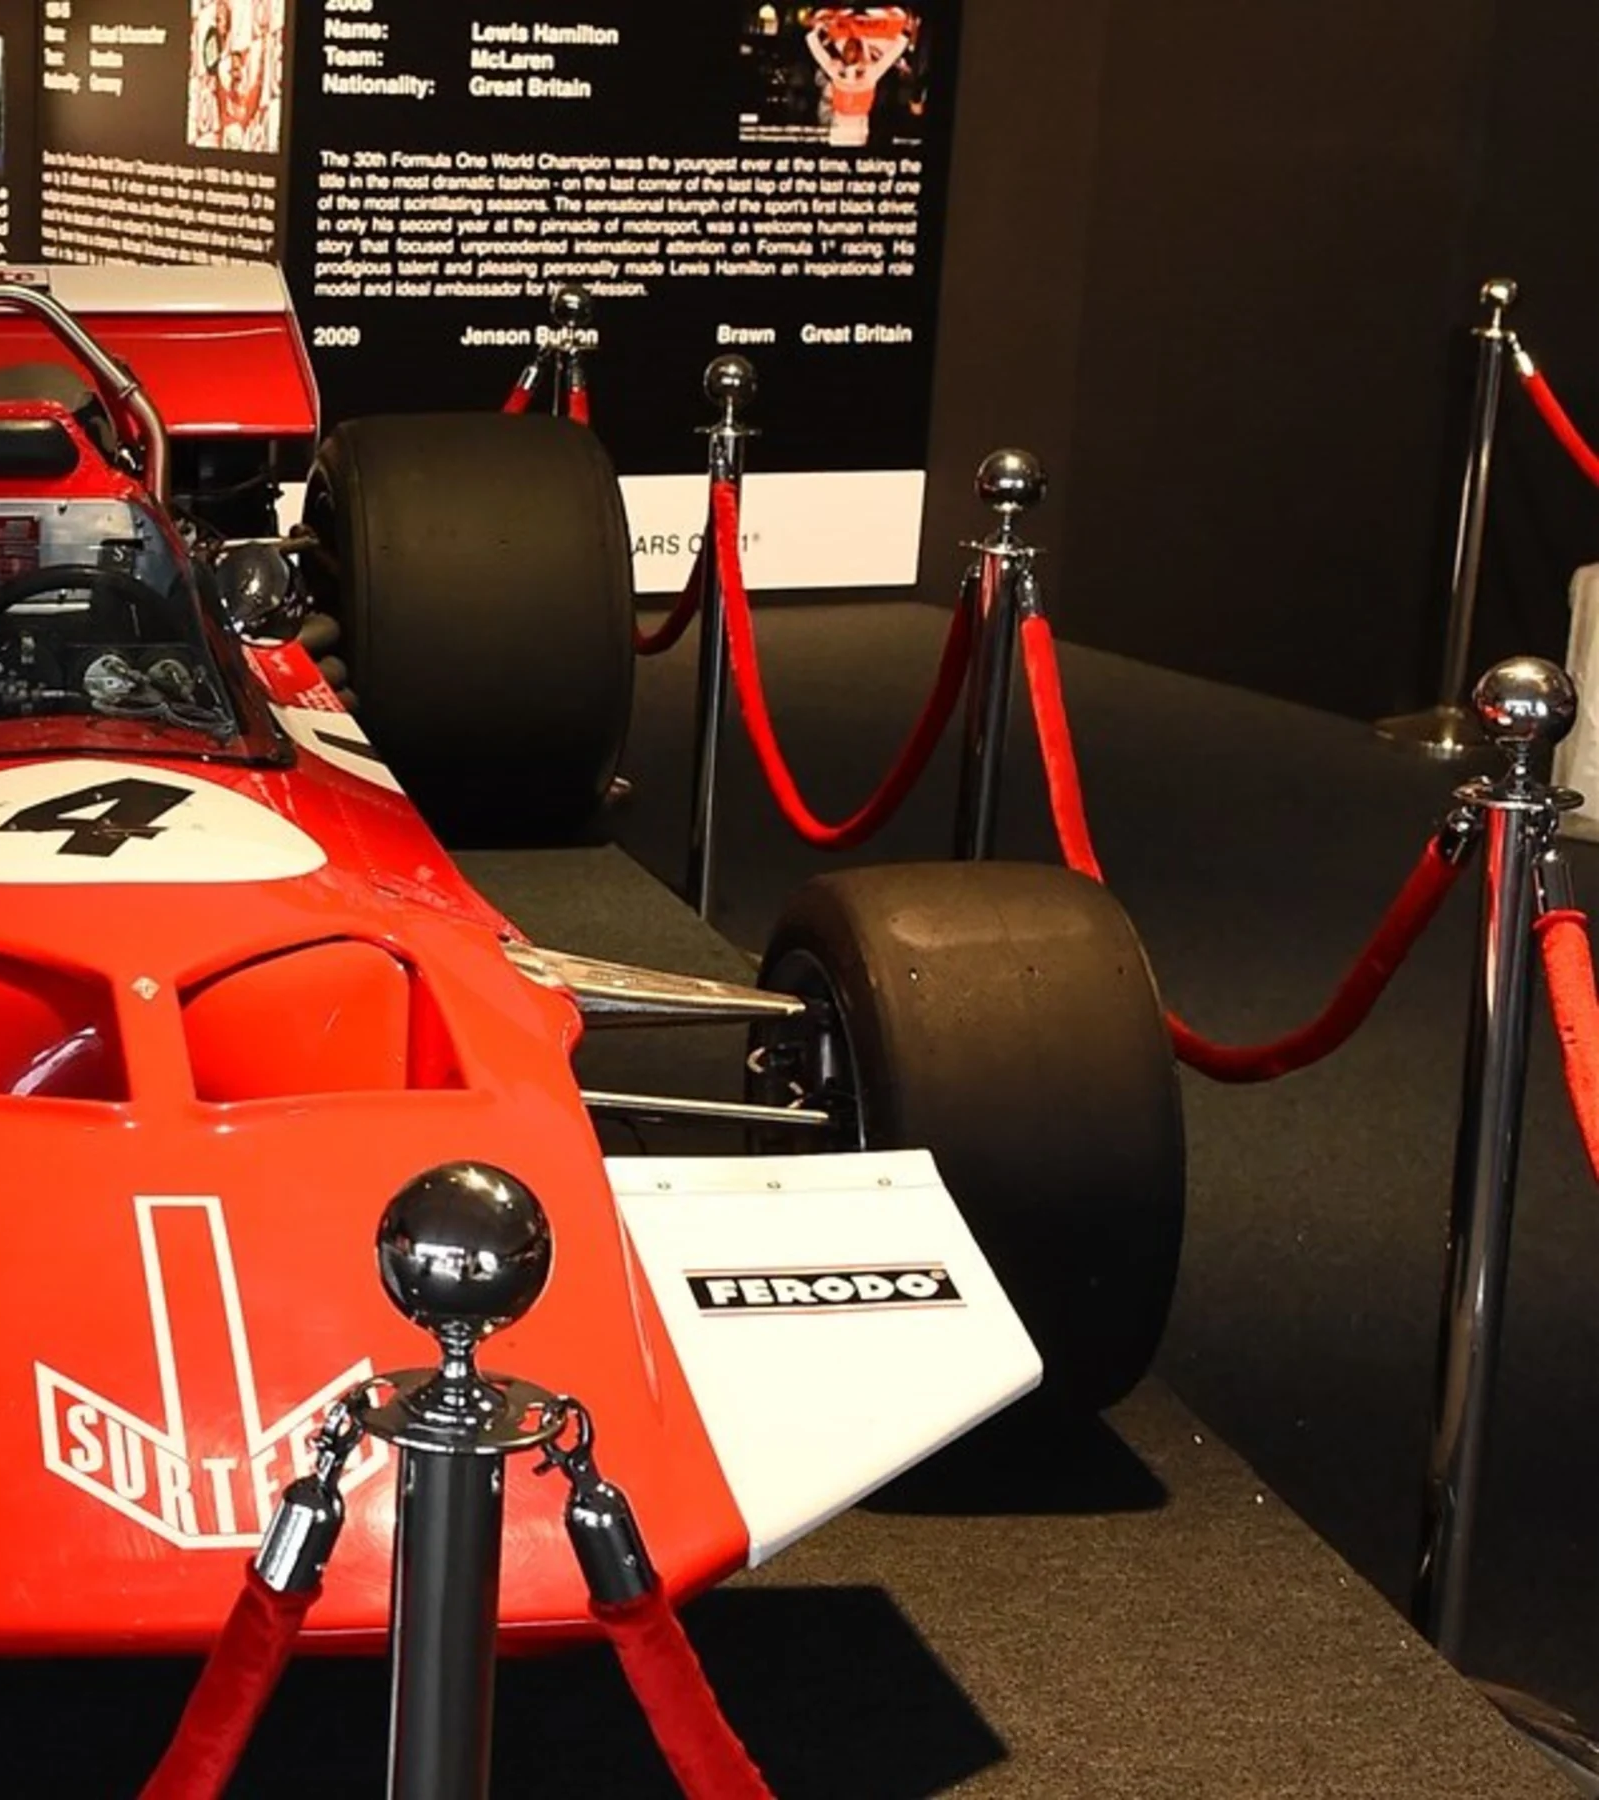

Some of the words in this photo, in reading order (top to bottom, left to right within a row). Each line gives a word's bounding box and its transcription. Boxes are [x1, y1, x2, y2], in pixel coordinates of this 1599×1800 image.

[325, 18, 388, 40] Name:
[472, 22, 529, 43] Lewis
[533, 23, 619, 44] Hamilton
[323, 45, 383, 66] Team:
[471, 49, 554, 70] McLaren
[323, 73, 435, 99] Nationality:
[469, 76, 523, 96] Great
[527, 77, 591, 97] Britain
[320, 151, 350, 167] The
[391, 151, 452, 168] Formula
[456, 152, 487, 169] One
[492, 154, 535, 169] World
[538, 153, 611, 172] Champion
[615, 158, 643, 170] was
[648, 156, 670, 170] the
[674, 158, 737, 175] youngest
[741, 159, 772, 172] ever
[775, 158, 789, 172] at
[793, 158, 815, 172] the
[856, 159, 896, 177] taking
[900, 159, 921, 173] the
[314, 327, 360, 346] 2009
[461, 326, 530, 345] Jenson
[717, 324, 775, 344] Brawn
[801, 324, 850, 343] Great
[854, 324, 912, 342] Britain
[705, 1273, 940, 1305] FERODO
